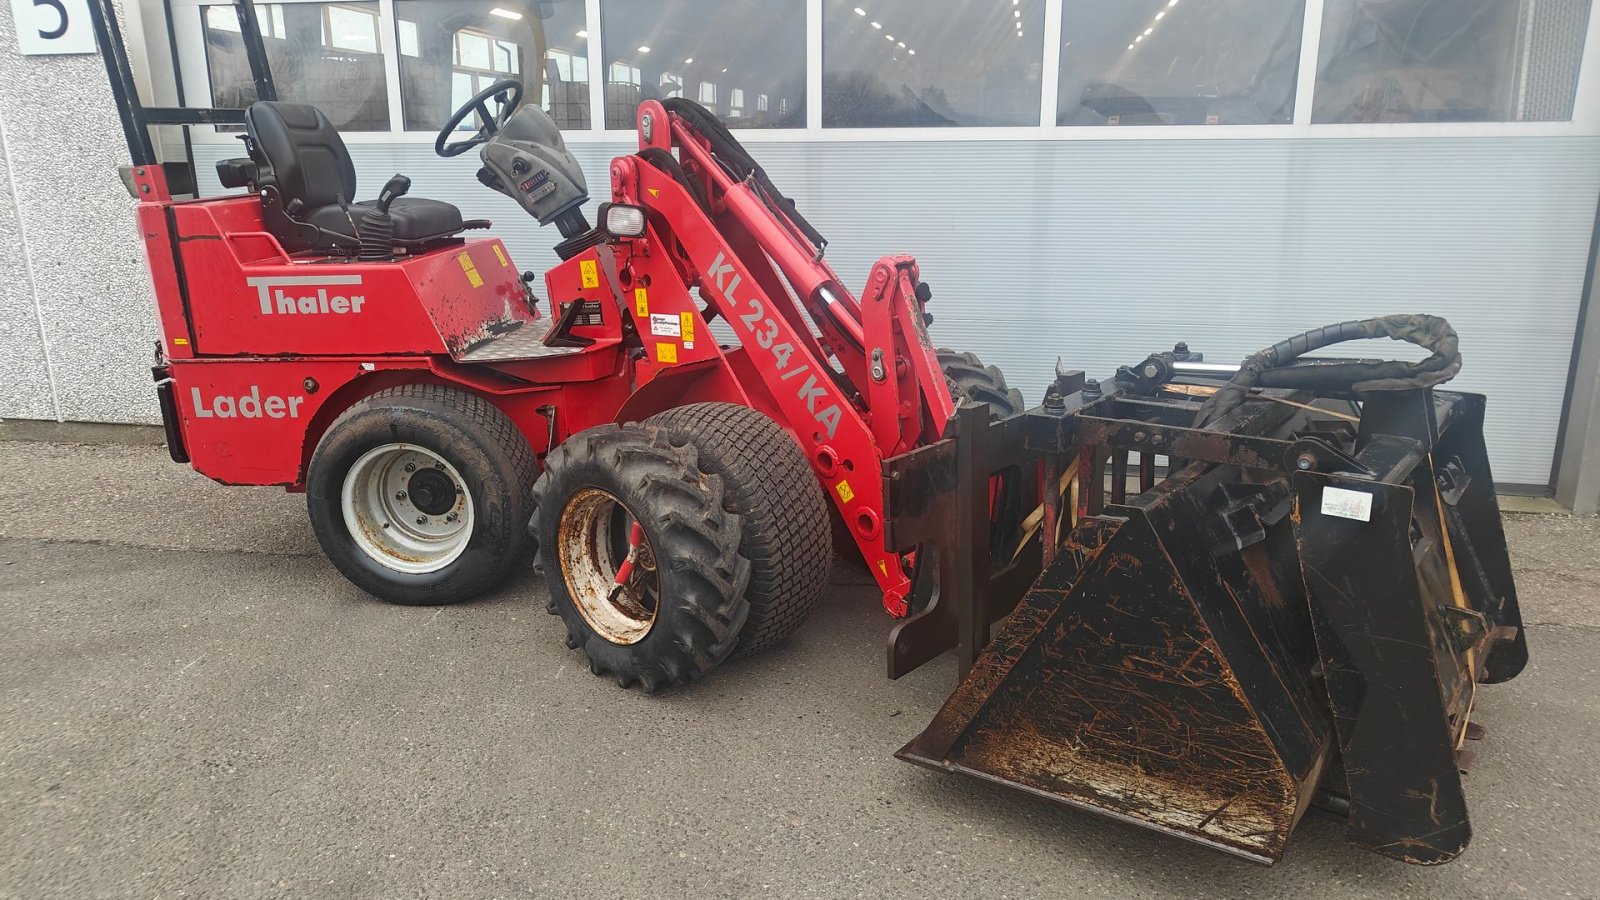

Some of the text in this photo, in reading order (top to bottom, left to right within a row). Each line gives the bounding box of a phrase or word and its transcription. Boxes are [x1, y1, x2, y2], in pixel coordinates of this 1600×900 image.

[246, 275, 366, 315] Thaler
[707, 251, 842, 440] KL 234/KA
[191, 385, 304, 418] Lader
